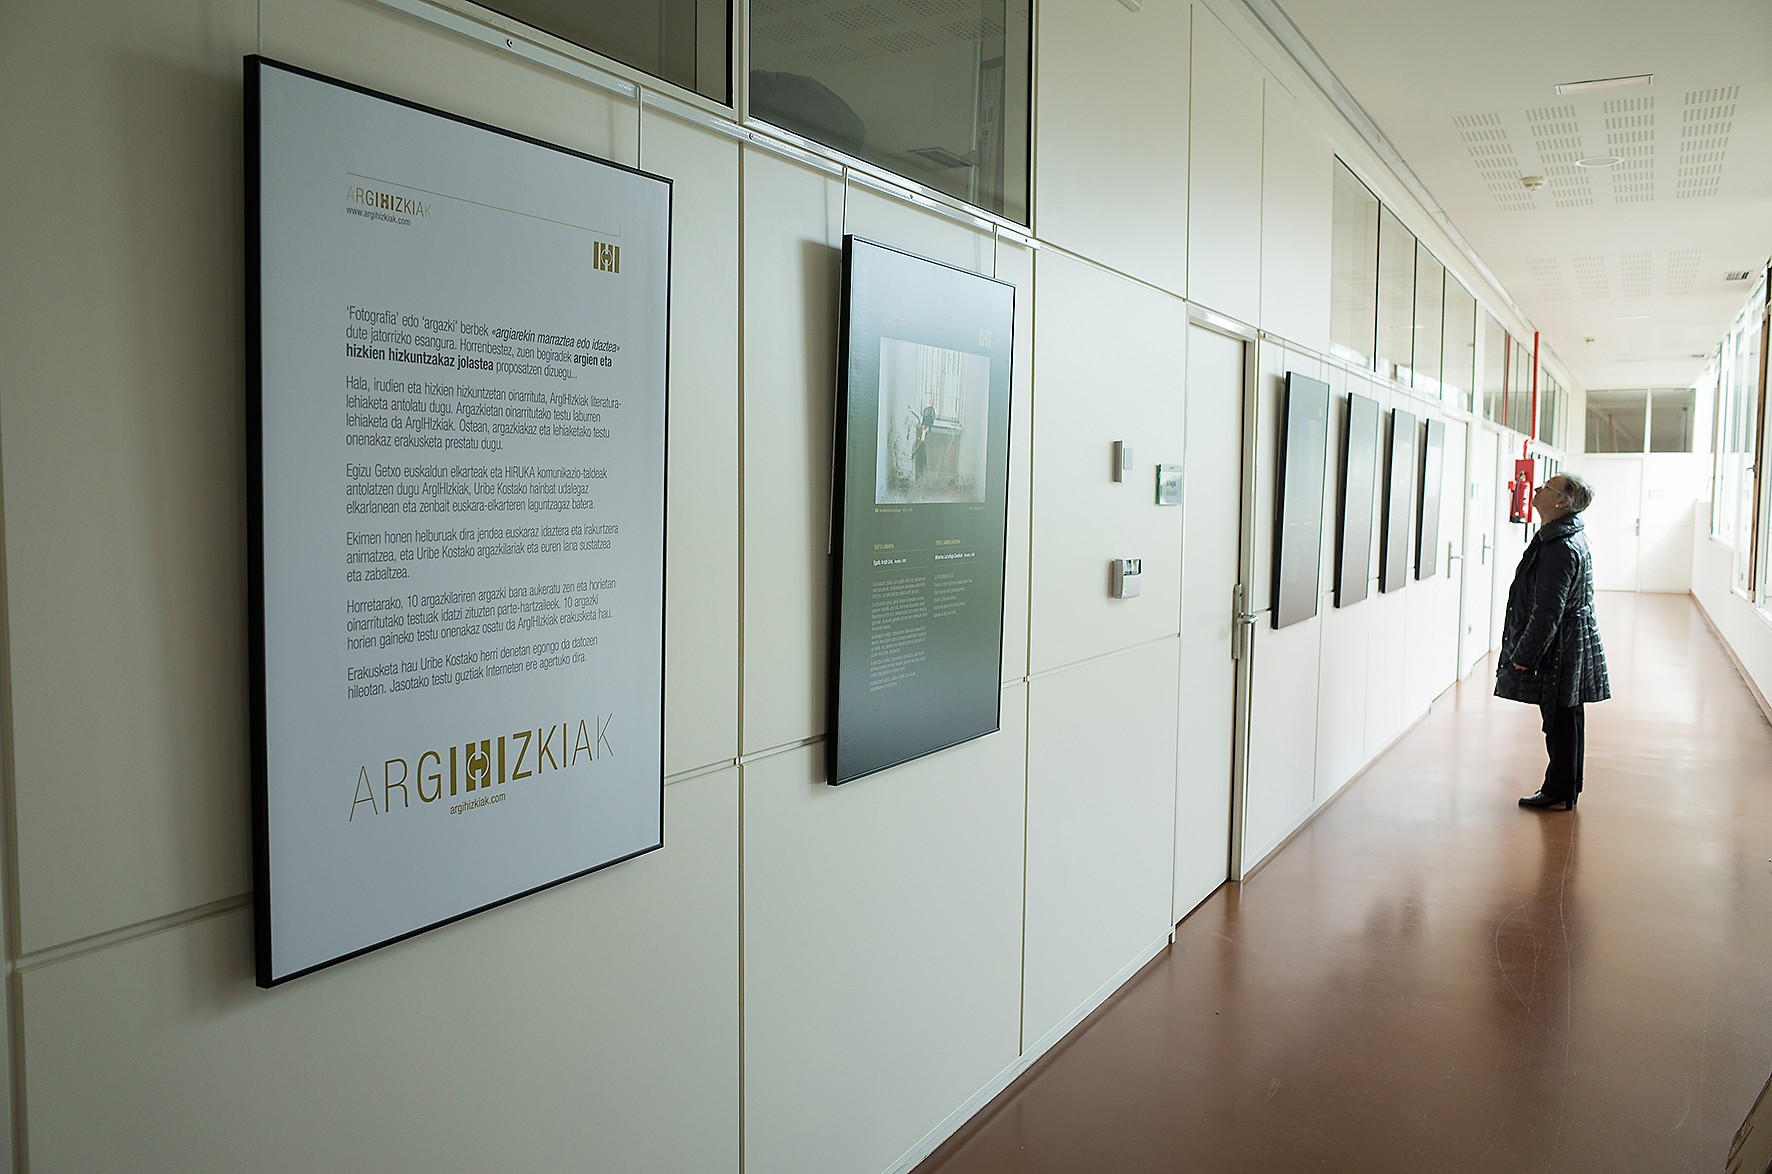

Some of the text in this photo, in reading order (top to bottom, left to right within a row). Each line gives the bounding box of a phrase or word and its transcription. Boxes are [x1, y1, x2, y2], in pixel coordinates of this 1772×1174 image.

[345, 207, 410, 225] www.argihizkiak.com
[346, 186, 432, 218] ARGIHIZKIAK
[346, 325, 612, 368] dute jatorrizko esangura. Horrenbestez, zuen begiradek argien eta
[402, 314, 418, 328] edo
[460, 321, 488, 337] berbek
[536, 334, 574, 348] marraztea
[576, 337, 590, 350] edo
[346, 343, 385, 361] hizkien
[388, 348, 455, 367] hizkuntzakaz
[457, 355, 493, 371] jolastea
[496, 362, 541, 376] proposatzen
[346, 376, 370, 393] Hala,
[373, 378, 404, 393] irudien
[407, 382, 421, 395] eta
[424, 382, 453, 397] hizkien
[456, 385, 506, 401] hizkuntzetan
[508, 389, 547, 406] oinarrituta,
[590, 396, 621, 409] literatura-
[346, 394, 600, 423] lehiaketa antolatu dugu. Argazkietan oinarritutako testu laburren
[346, 413, 387, 428] lehiaketa
[390, 415, 402, 429] da
[459, 419, 489, 435] Ostean,
[492, 422, 537, 437] argazkiakaz
[539, 424, 550, 435] eta
[552, 424, 591, 437] lehiaketako
[593, 427, 609, 438] testu
[345, 433, 503, 453] onenakaz erakusketa prestatu dugu.
[346, 463, 607, 481] Egizu Getxo euskaldun elkarteak eta HIRUKA komunikazio-taldeak
[346, 482, 393, 495] antolatzen
[396, 482, 419, 498] dugu
[474, 482, 495, 495] Uribe
[497, 482, 527, 494] Kostako
[529, 482, 556, 494] hainbat
[558, 482, 589, 497] udalegaz
[346, 498, 595, 514] elkarlanean eta zenbait euskara-elkarteren laguntzagaz batera.
[346, 523, 618, 546] Ekimen honen helburuak dira jendea euskaraz idaztera eta irakurtzera
[346, 539, 611, 564] animatzea, eta Uribe Kostako argazkilariak eta euren lana sustatzea
[346, 565, 410, 582] eta zabaltzea.
[346, 578, 615, 614] Horretarako, 10 argazkilariren argazki bana aukeratu zen eta horietan
[346, 593, 598, 632] oinarritutako testuak idatzi zituzten parte-hartzaileek. 10 argazki
[347, 634, 376, 650] horien
[379, 629, 414, 649] gaineko
[416, 628, 438, 641] testu
[440, 622, 480, 638] onenakaz
[482, 620, 503, 633] osatu
[505, 618, 515, 630] da
[559, 609, 596, 624] erakusketa
[598, 607, 612, 619] hau.
[347, 637, 597, 681] Erakusketa hau Uribe Kostako herri denetan egongo da datozen
[347, 651, 586, 699] hileotan. Jasotako testu guztiak Interneten ere agertuko dira.
[348, 712, 614, 822] ARGIHIZKIAK
[449, 792, 506, 815] argihizkiak.com
